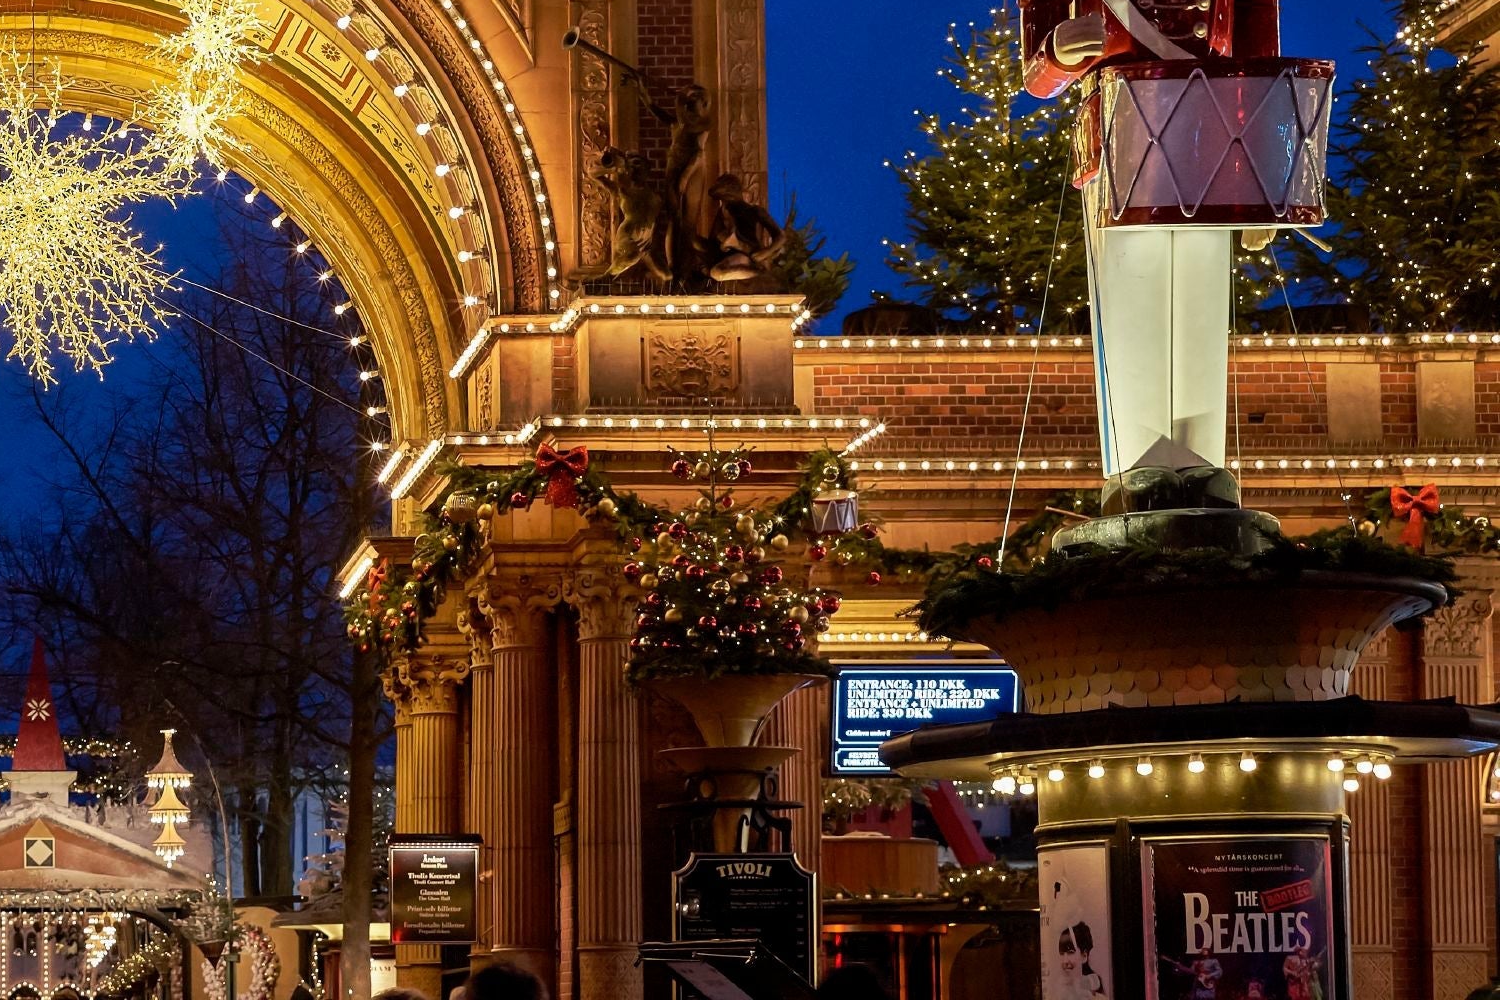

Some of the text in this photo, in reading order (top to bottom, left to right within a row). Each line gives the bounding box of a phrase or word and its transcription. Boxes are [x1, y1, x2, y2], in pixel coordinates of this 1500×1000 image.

[847, 679, 966, 690] ENTRANCE: 110 DKK
[847, 689, 1000, 700] UNLIMITED RIDE: 220 DKK
[847, 699, 910, 709] ENTRANCE
[919, 699, 985, 709] UNLIMITED
[847, 708, 880, 719] RIDE:
[905, 708, 933, 719] DKK
[1214, 853, 1283, 861] NYTÅRSKONCERT
[715, 862, 773, 878] TIVOLI
[1235, 890, 1259, 907] THE
[1266, 884, 1311, 906] BOOTLEG
[1183, 892, 1313, 954] BEATLES
